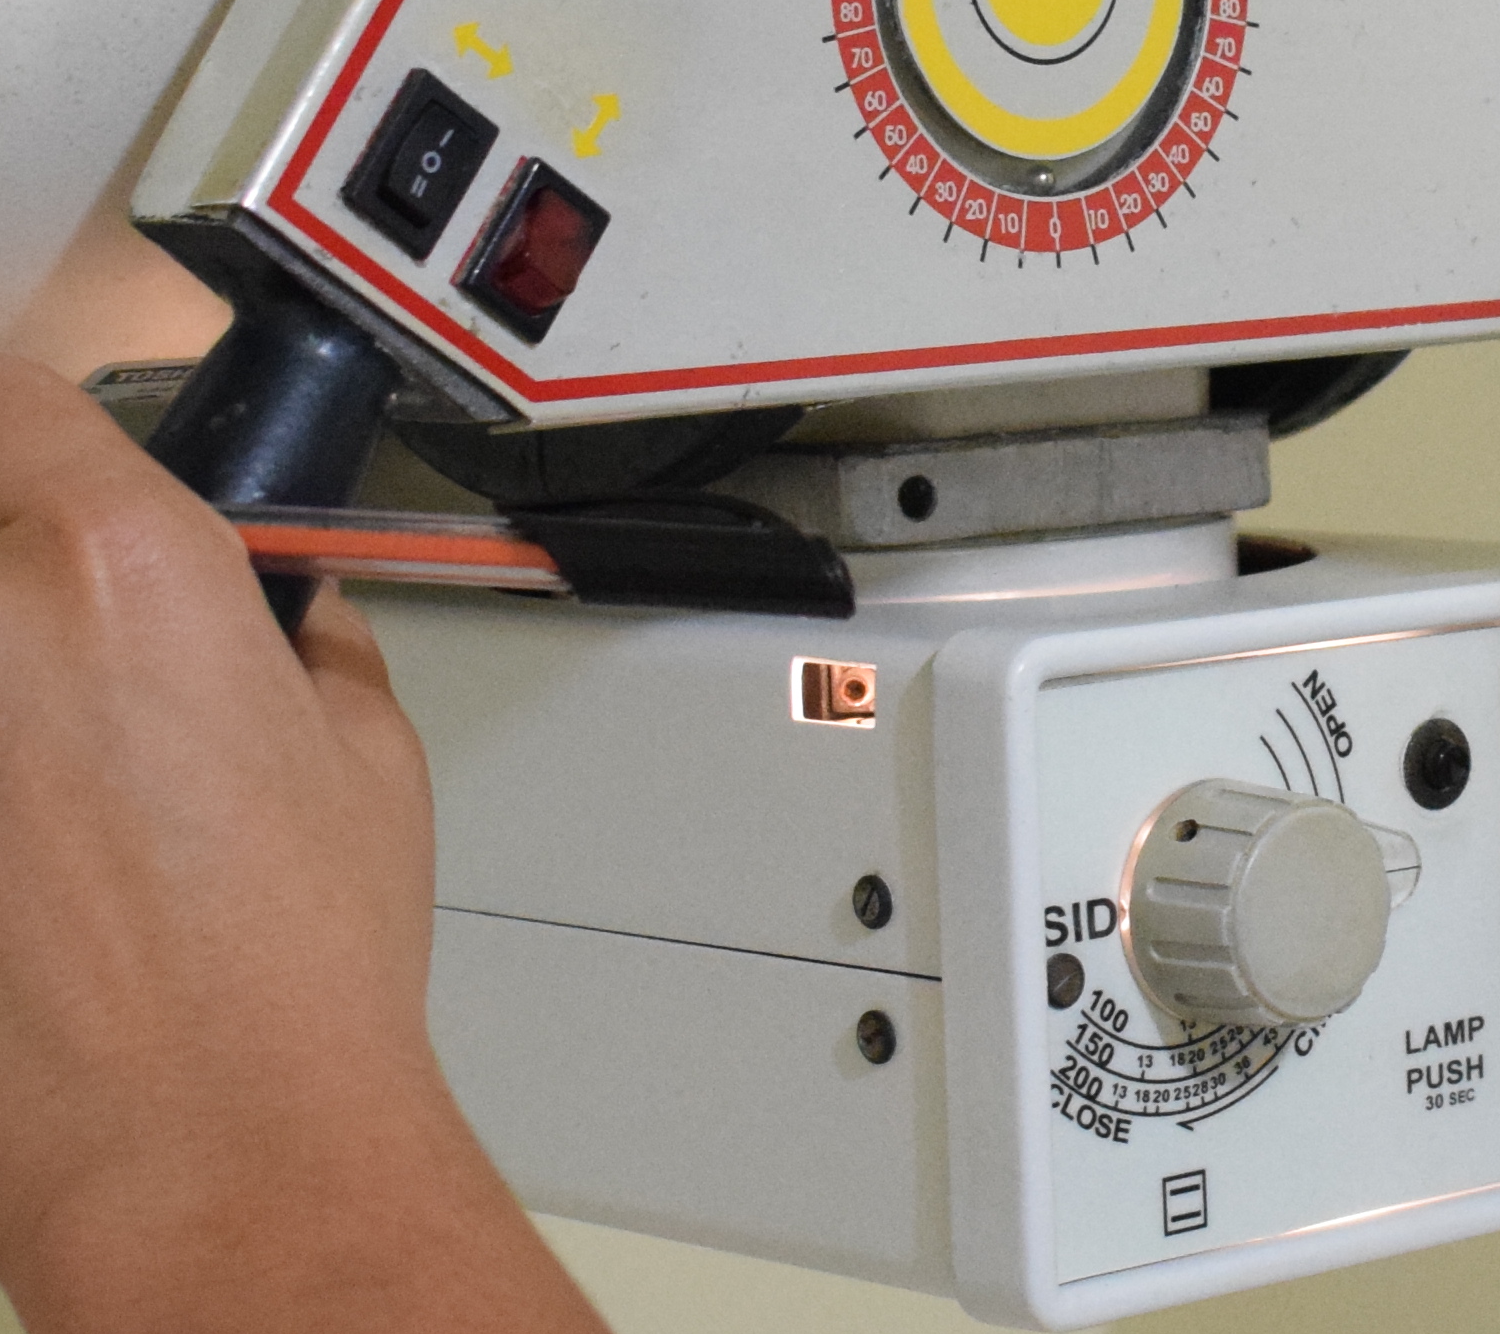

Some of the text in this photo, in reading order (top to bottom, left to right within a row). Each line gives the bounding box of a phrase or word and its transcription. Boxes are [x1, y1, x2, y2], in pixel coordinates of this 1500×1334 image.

[840, 2, 863, 23] 80
[851, 47, 874, 69] 70
[1214, 37, 1236, 58] 70
[1201, 76, 1224, 97] 60
[864, 90, 887, 112] 60
[1190, 111, 1212, 133] 50
[884, 125, 907, 147] 50
[906, 155, 928, 176] 40
[1168, 144, 1190, 165] 40
[935, 181, 957, 203] 30
[1148, 172, 1170, 193] 30
[965, 200, 987, 221] 20
[1120, 193, 1142, 214] 20
[998, 212, 1019, 234] 10
[1049, 217, 1062, 238] 0
[1088, 209, 1109, 230] 10
[1303, 669, 1352, 758] OPEN
[1044, 897, 1118, 948] SID
[1089, 989, 1129, 1034] 100
[1405, 1015, 1485, 1054] LAMP
[1075, 1023, 1115, 1069] 150
[1137, 1054, 1154, 1068] 13
[1170, 1052, 1186, 1066] 18
[1188, 1048, 1206, 1064] 20
[1210, 1037, 1228, 1055] 25
[1058, 1054, 1104, 1102] 200
[1112, 1082, 1129, 1099] 13
[1134, 1089, 1151, 1103] 18
[1152, 1089, 1171, 1103] 20
[1173, 1084, 1192, 1101] 25
[1192, 1080, 1209, 1097] 28
[1210, 1074, 1227, 1091] 30
[1407, 1054, 1484, 1094] PUSH
[1425, 1088, 1475, 1111] 30 SEC
